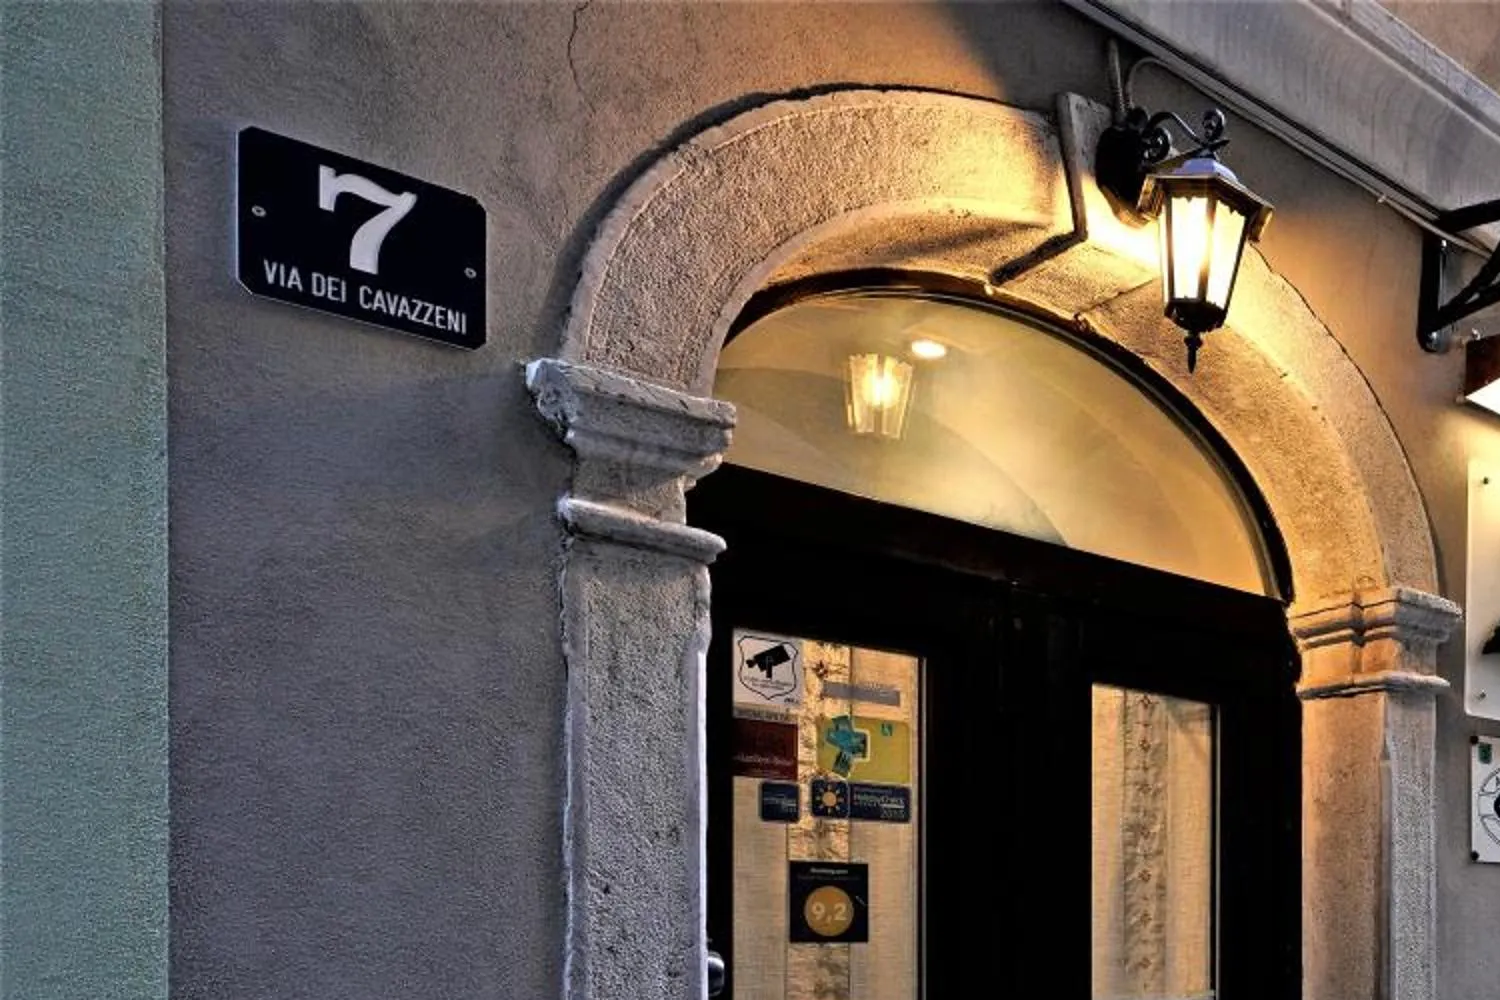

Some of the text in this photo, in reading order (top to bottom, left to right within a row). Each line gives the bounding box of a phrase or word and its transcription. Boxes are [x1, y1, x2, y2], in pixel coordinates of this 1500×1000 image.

[319, 164, 417, 275] 7
[263, 259, 468, 335] VIA DEI CAVAZZENI
